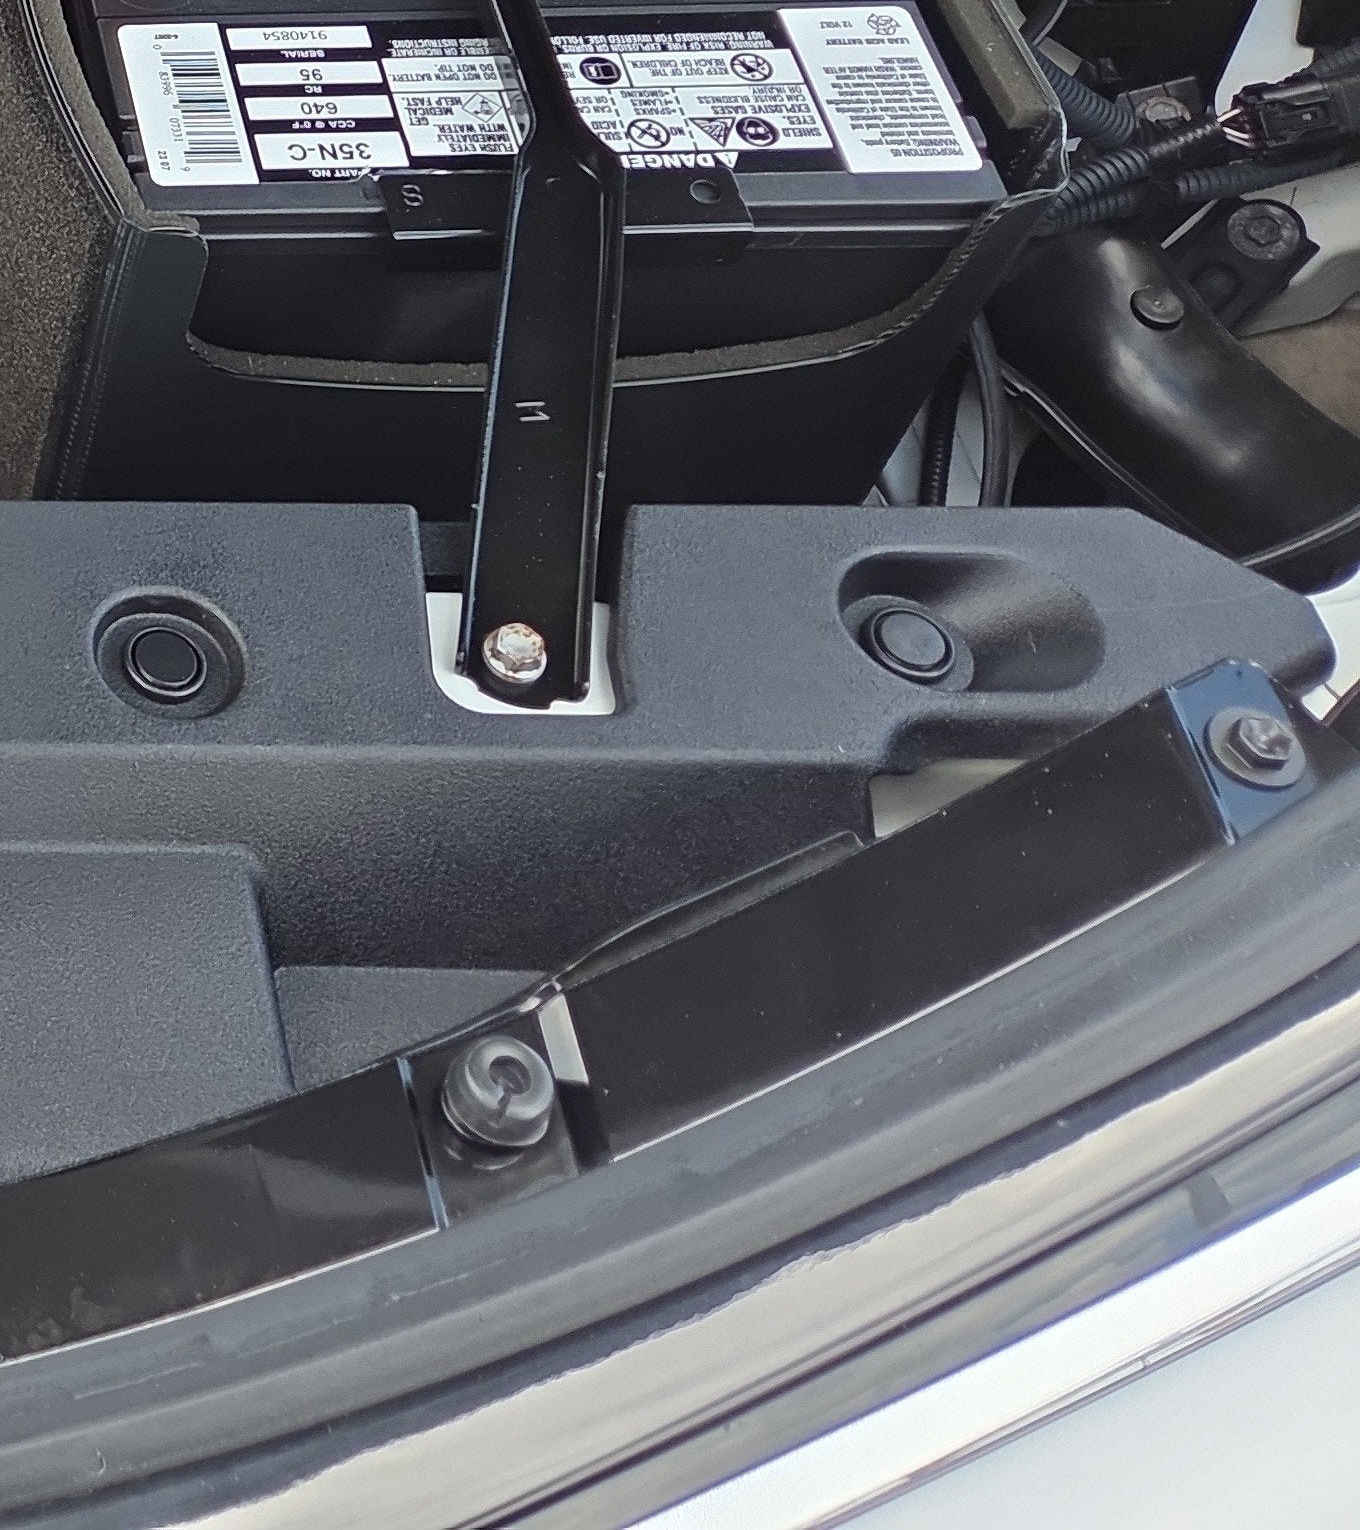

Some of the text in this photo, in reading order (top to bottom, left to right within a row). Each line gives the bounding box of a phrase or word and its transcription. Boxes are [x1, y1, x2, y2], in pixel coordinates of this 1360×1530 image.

[819, 20, 853, 28] 12 VOLT
[262, 29, 327, 41] 9140854
[607, 35, 652, 43] INVERTED
[674, 33, 743, 41] RECOMMENDED
[746, 32, 765, 40] NOT
[611, 43, 661, 51] EXPLOSION
[701, 41, 723, 49] RISK
[280, 50, 325, 58] SERIAL
[455, 64, 477, 72] NOT
[480, 64, 494, 72] DO
[650, 68, 667, 76] THE
[669, 68, 682, 76] OF
[299, 68, 323, 81] 95
[434, 73, 459, 81] OPEN
[462, 73, 481, 81] NOT
[483, 72, 497, 80] DO
[304, 85, 322, 93] RC
[401, 97, 463, 106] HELP FAST.
[594, 96, 608, 104] OR
[696, 95, 806, 104] CAN CAUSE BLINDNESS
[301, 102, 337, 115] 640
[404, 107, 454, 115] MEDICAL
[593, 105, 612, 113] CAN
[711, 104, 810, 115] EXPLOSIVE GASES
[327, 120, 355, 128] CCA
[409, 117, 429, 126] GET
[591, 121, 617, 130] ACID
[480, 124, 508, 133] WITH
[670, 126, 684, 137] NO
[781, 128, 822, 137] SHIELD
[436, 134, 510, 142] IMMEDIATELY
[597, 132, 622, 140] SUL
[287, 142, 372, 161] 35N-C
[449, 144, 514, 152] FLUSH EYES
[890, 148, 964, 157] PROPOSITION 65
